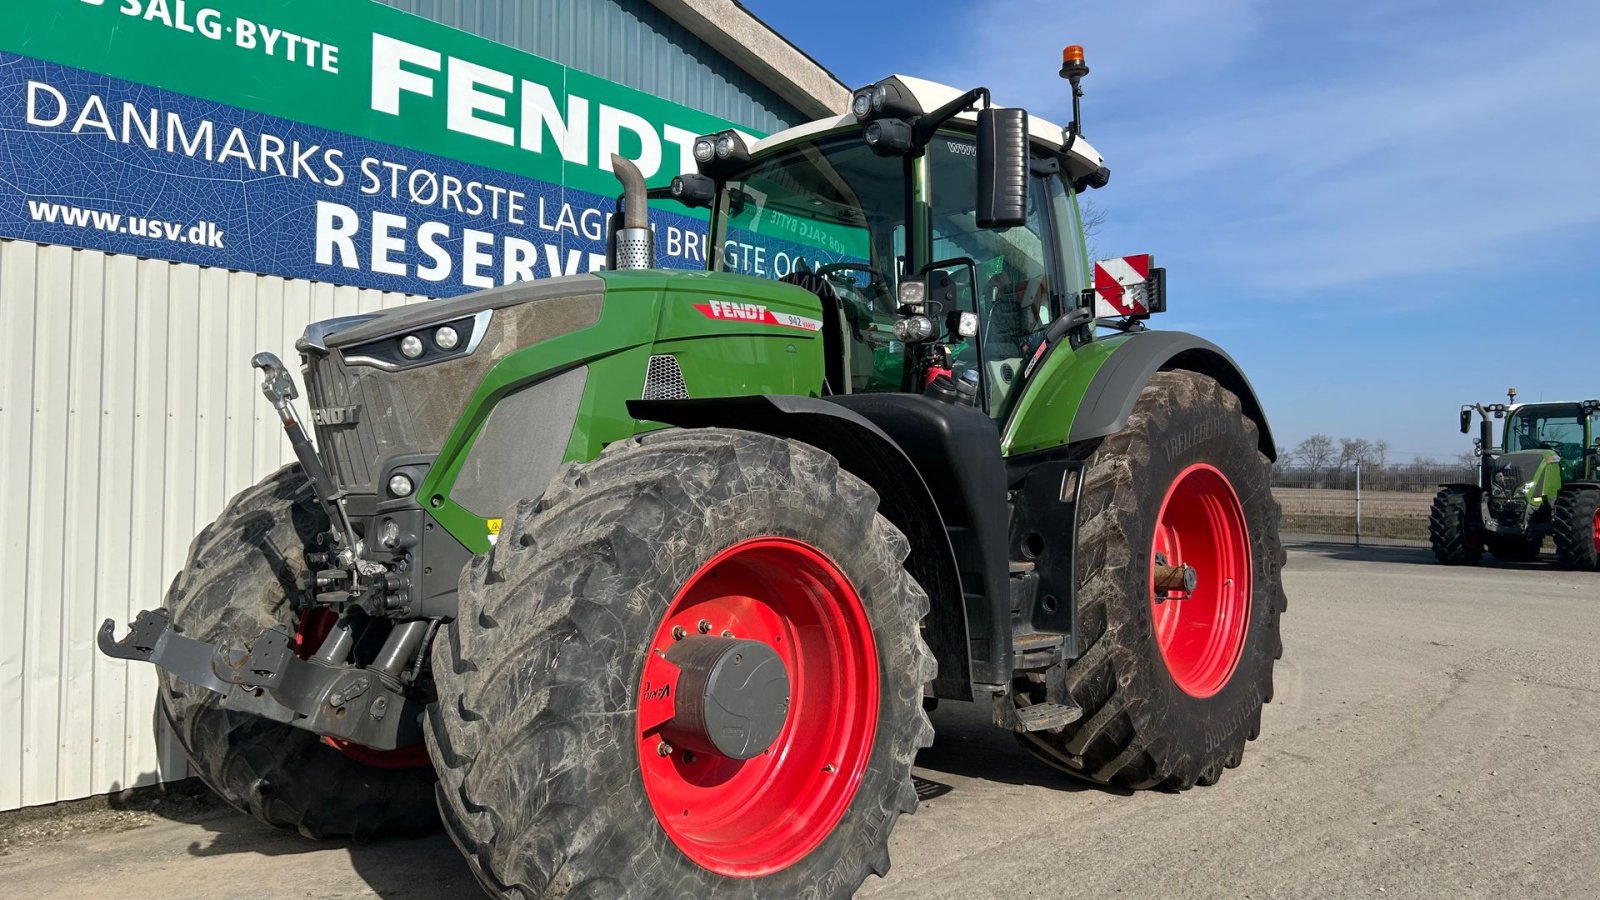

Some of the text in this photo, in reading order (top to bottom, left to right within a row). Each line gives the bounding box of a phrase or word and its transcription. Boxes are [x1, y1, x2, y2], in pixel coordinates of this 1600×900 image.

[26, 80, 345, 188] DANMARKS
[360, 157, 525, 225] STØRSTE
[28, 200, 225, 250] www.usv.dk
[708, 299, 768, 321] FENDT
[788, 315, 802, 327] 942
[311, 405, 361, 426] ENDT
